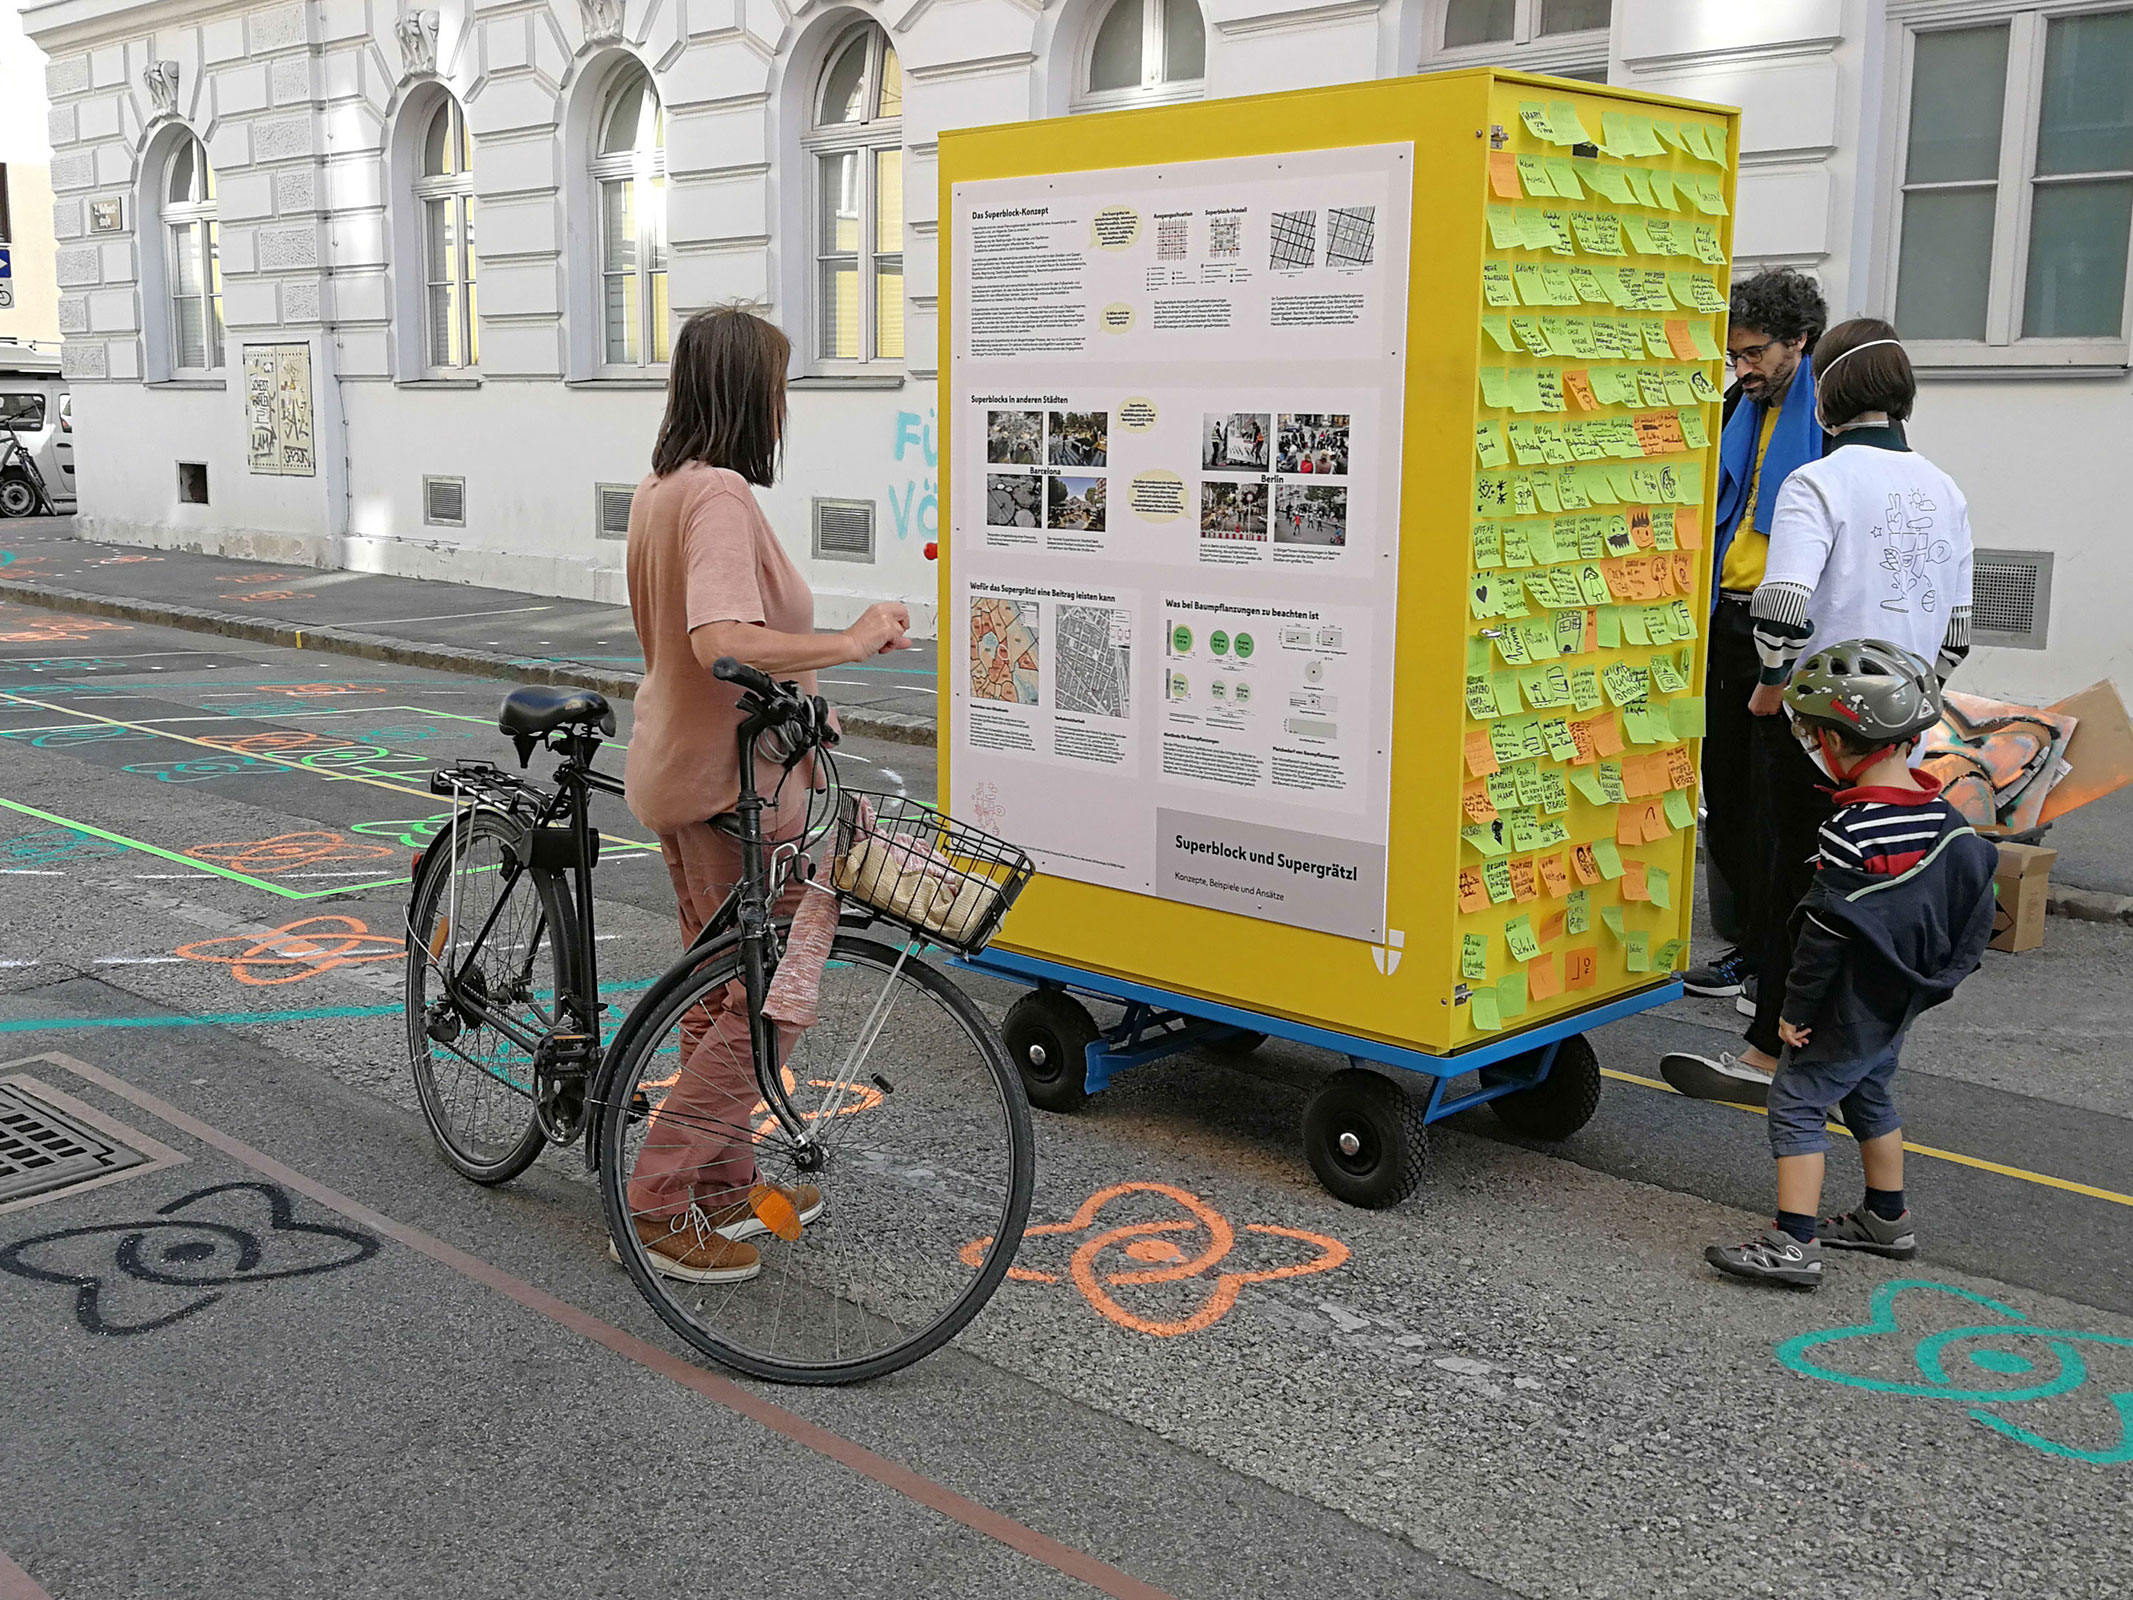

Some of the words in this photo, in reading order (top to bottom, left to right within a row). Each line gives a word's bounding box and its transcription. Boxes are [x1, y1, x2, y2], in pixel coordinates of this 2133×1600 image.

[972, 211, 984, 220] Das
[984, 206, 1049, 220] Superblock-Konzept
[971, 395, 1008, 405] Superblocks
[1009, 395, 1015, 403] in
[1016, 396, 1042, 404] anderen
[1042, 395, 1069, 404] Städten
[1029, 466, 1061, 475] Barcelona
[1261, 474, 1284, 483] Berlin
[969, 581, 989, 591] Wofür
[990, 584, 1000, 592] das
[1001, 585, 1036, 596] Supergrätzl
[1051, 589, 1075, 600] Beitrag
[1076, 591, 1098, 601] leisten
[1099, 594, 1116, 602] kann
[1165, 598, 1181, 608] Was
[1182, 600, 1193, 609] bei
[1194, 602, 1261, 617] Baumpflanzungen
[1261, 607, 1271, 616] zu
[1271, 607, 1308, 620] beachten
[1309, 611, 1319, 620] ist
[1175, 834, 1247, 861] Superblock
[1249, 851, 1275, 866] und
[1277, 853, 1357, 881] Supergrätzl
[1174, 871, 1209, 887] Konzepte,
[1209, 878, 1240, 893] Beispiele
[1240, 886, 1255, 895] und
[1255, 888, 1285, 901] Ansätze
